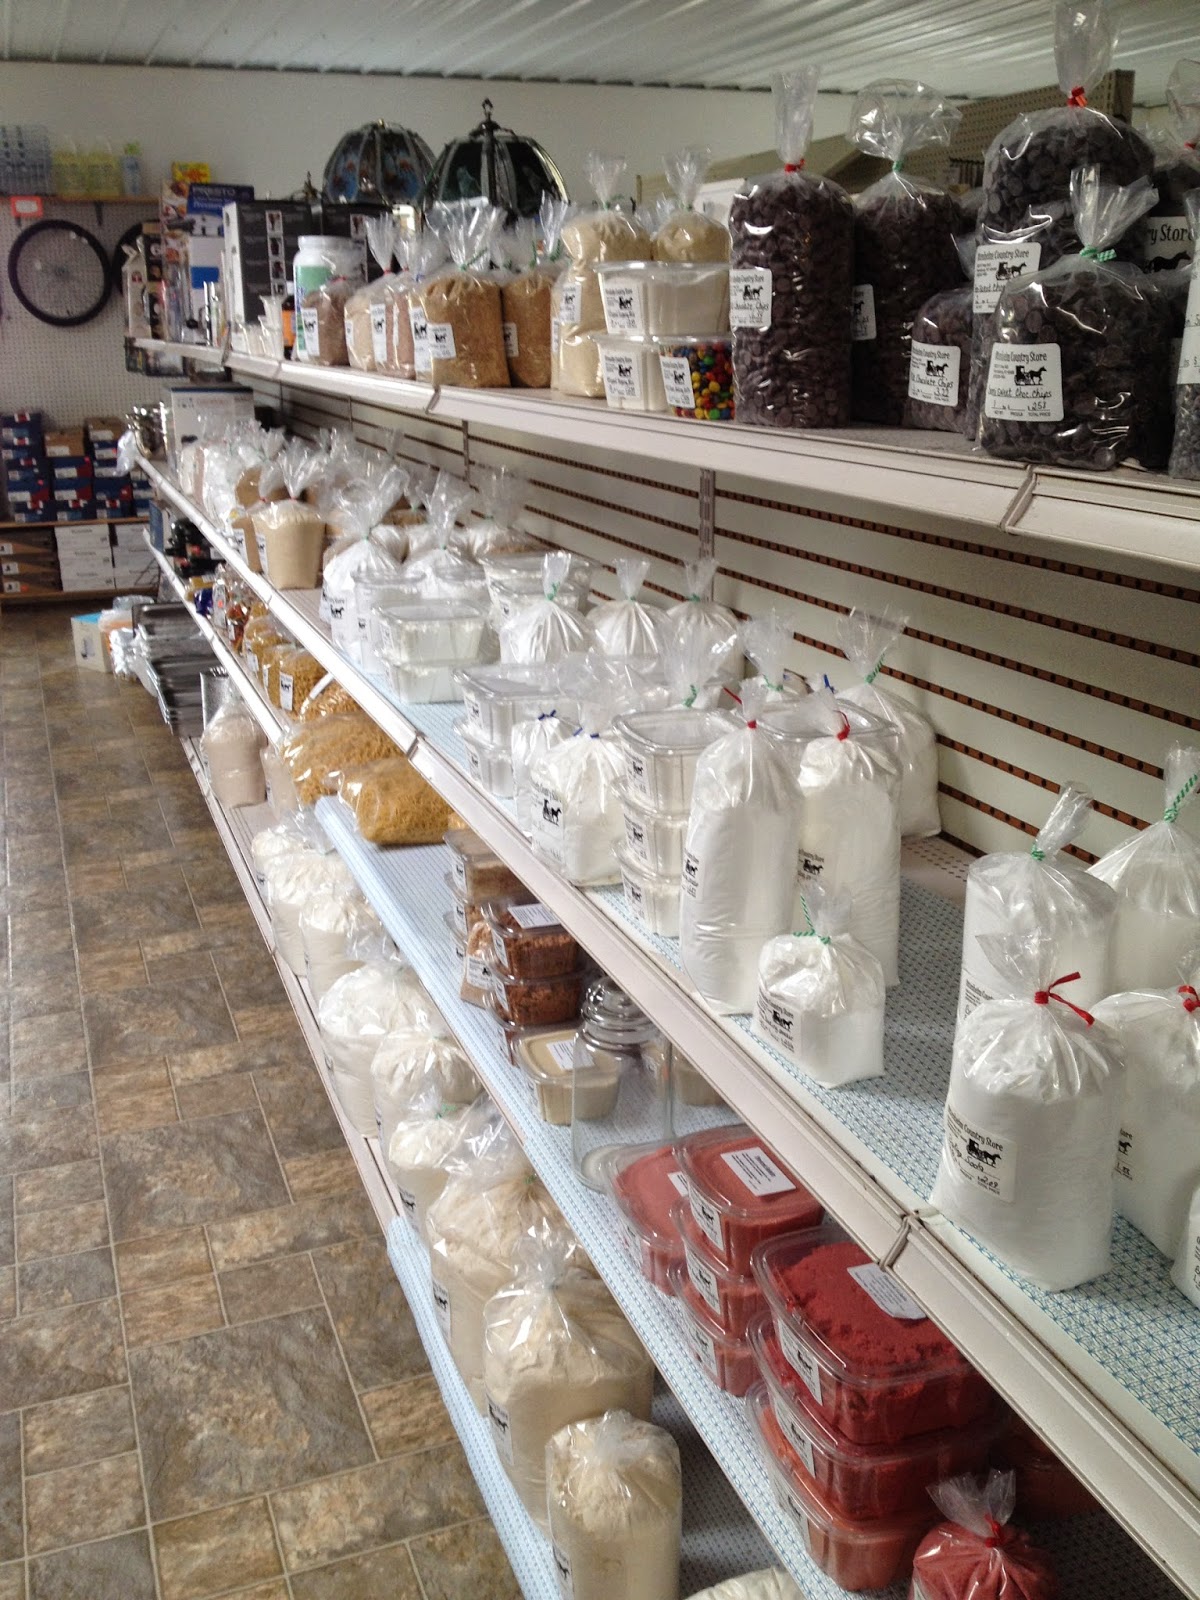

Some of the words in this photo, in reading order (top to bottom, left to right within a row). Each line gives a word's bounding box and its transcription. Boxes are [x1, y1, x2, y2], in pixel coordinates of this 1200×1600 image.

[1014, 248, 1029, 258] Store
[1010, 351, 1029, 364] Country
[1029, 350, 1047, 361] Store
[963, 1123, 986, 1145] Country
[986, 1136, 1004, 1152] Store
[965, 1155, 984, 1173] Soda
